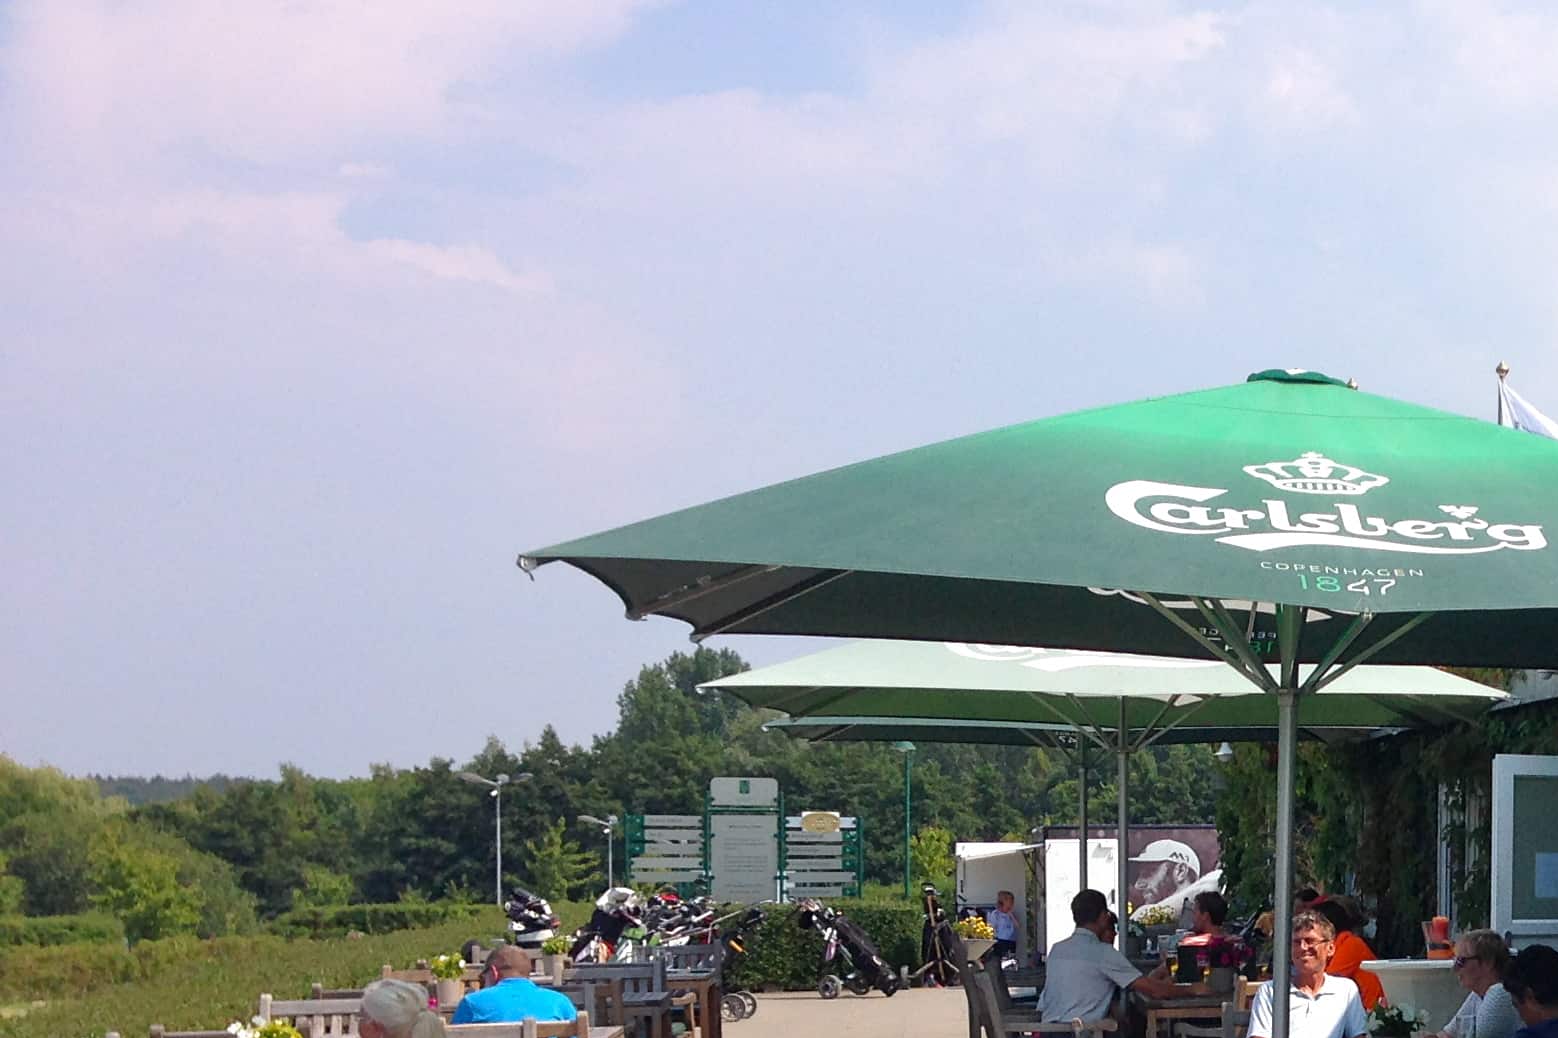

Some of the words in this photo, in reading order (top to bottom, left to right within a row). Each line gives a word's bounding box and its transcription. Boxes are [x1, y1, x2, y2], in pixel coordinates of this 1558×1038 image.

[1105, 480, 1549, 555] Carlsberg
[1260, 560, 1424, 577] COPENHAGEN
[1297, 573, 1396, 596] 1847
